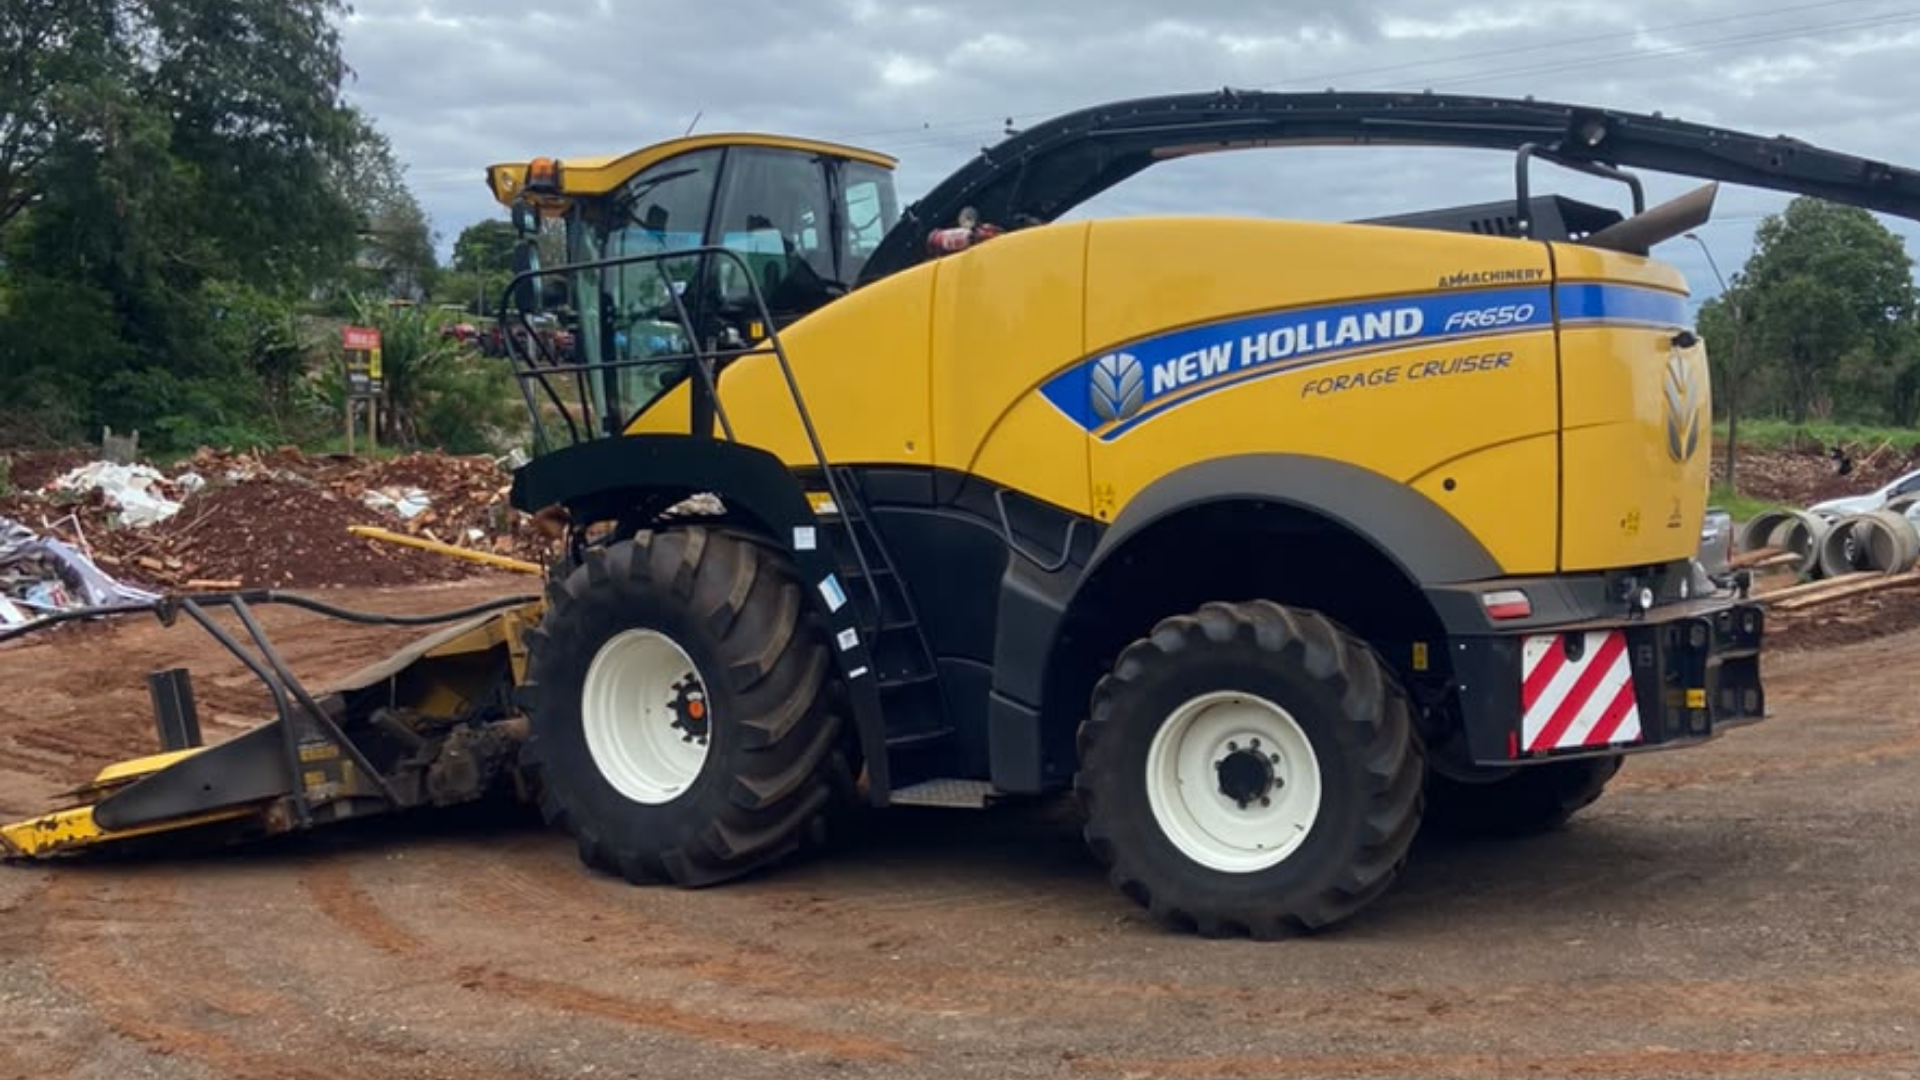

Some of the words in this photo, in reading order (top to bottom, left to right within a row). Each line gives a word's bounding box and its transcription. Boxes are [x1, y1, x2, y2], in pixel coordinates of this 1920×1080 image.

[1444, 303, 1535, 332] FR650
[1152, 341, 1233, 394] NEW
[1241, 307, 1424, 366] HOLLAND
[1301, 366, 1401, 398] FORAGE
[1407, 351, 1513, 379] CRUISER
